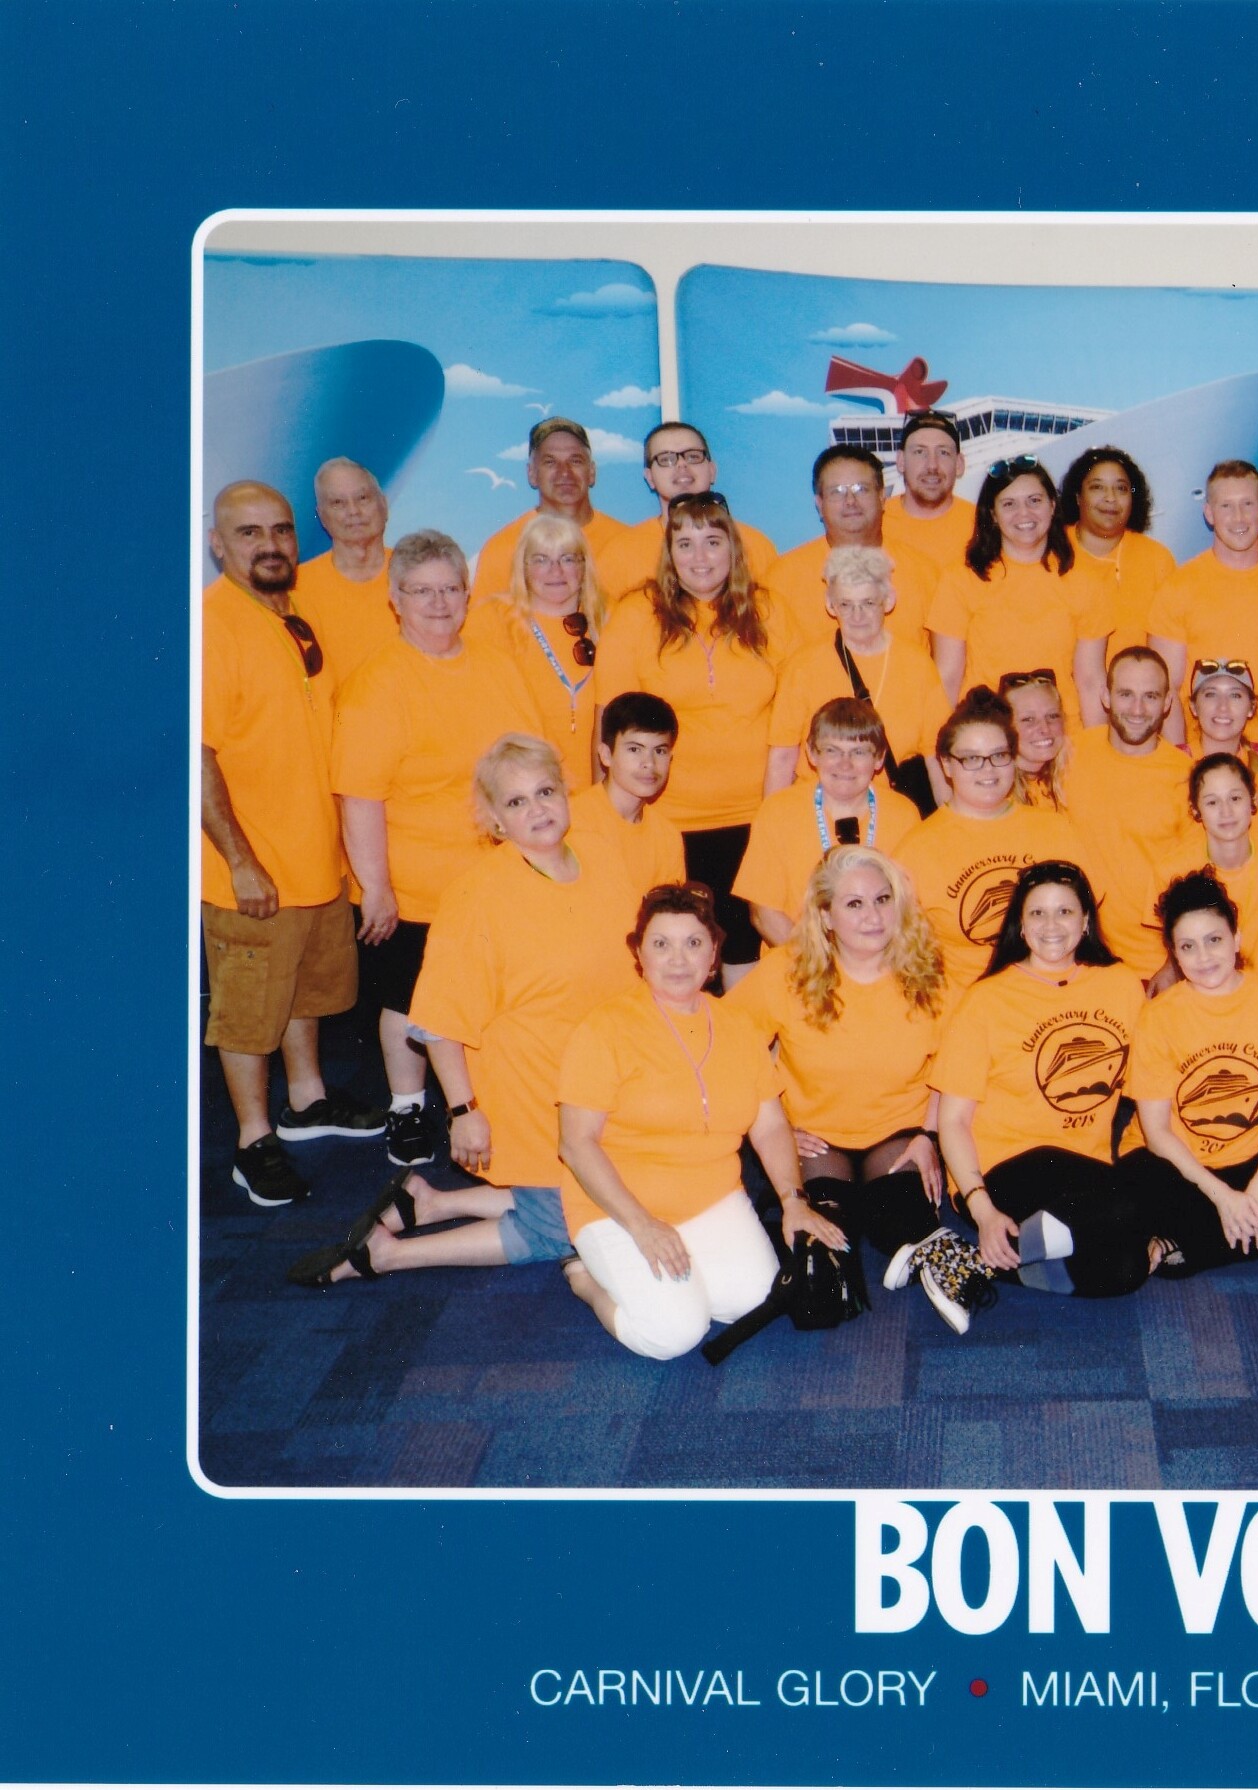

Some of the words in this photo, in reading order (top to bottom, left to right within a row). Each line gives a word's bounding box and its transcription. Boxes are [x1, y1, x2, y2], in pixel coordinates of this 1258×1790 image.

[947, 854, 1016, 899] Anniversary
[1022, 1009, 1088, 1053] Anniversary
[1094, 1008, 1130, 1040] Cruise
[1062, 1113, 1096, 1129] 2018
[1200, 1139, 1226, 1154] 201
